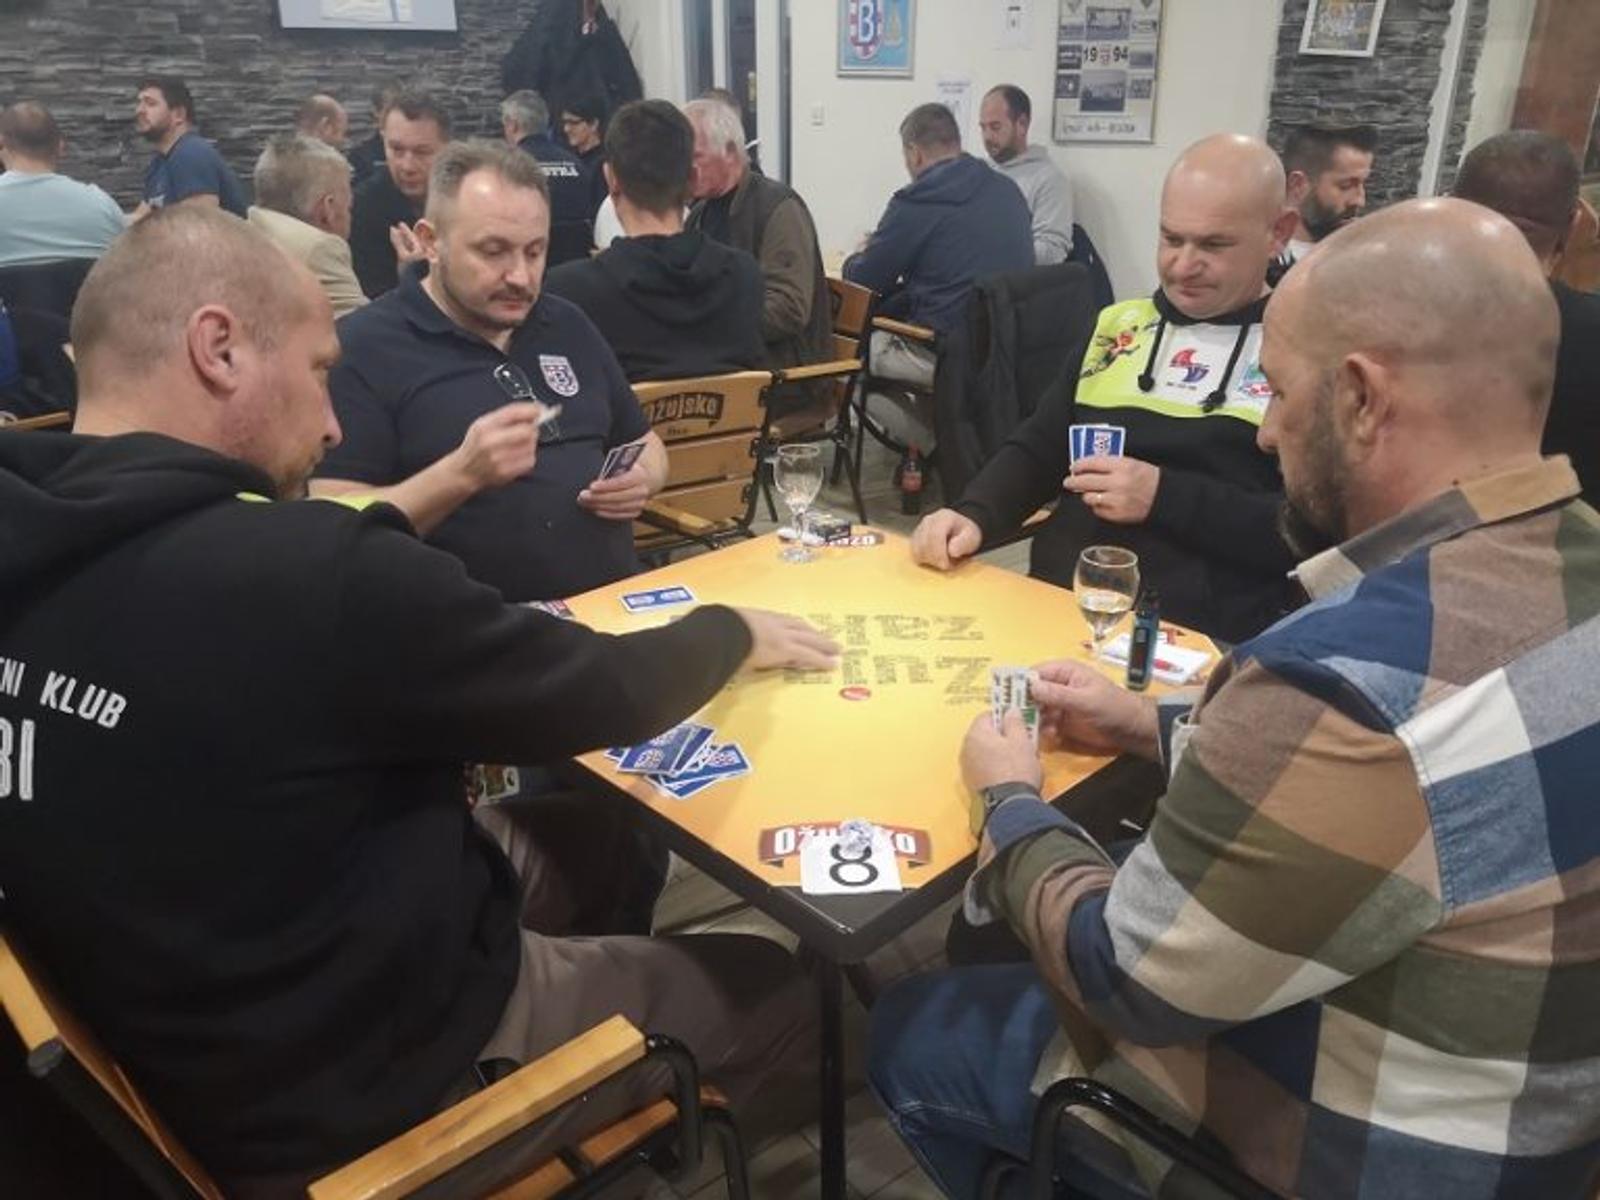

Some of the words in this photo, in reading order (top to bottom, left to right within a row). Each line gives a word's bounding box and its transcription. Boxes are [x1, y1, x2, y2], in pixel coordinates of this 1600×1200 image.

[1084, 46, 1098, 62] 19
[1113, 46, 1128, 62] 94
[40, 670, 127, 729] KLUB
[829, 842, 878, 887] 8
